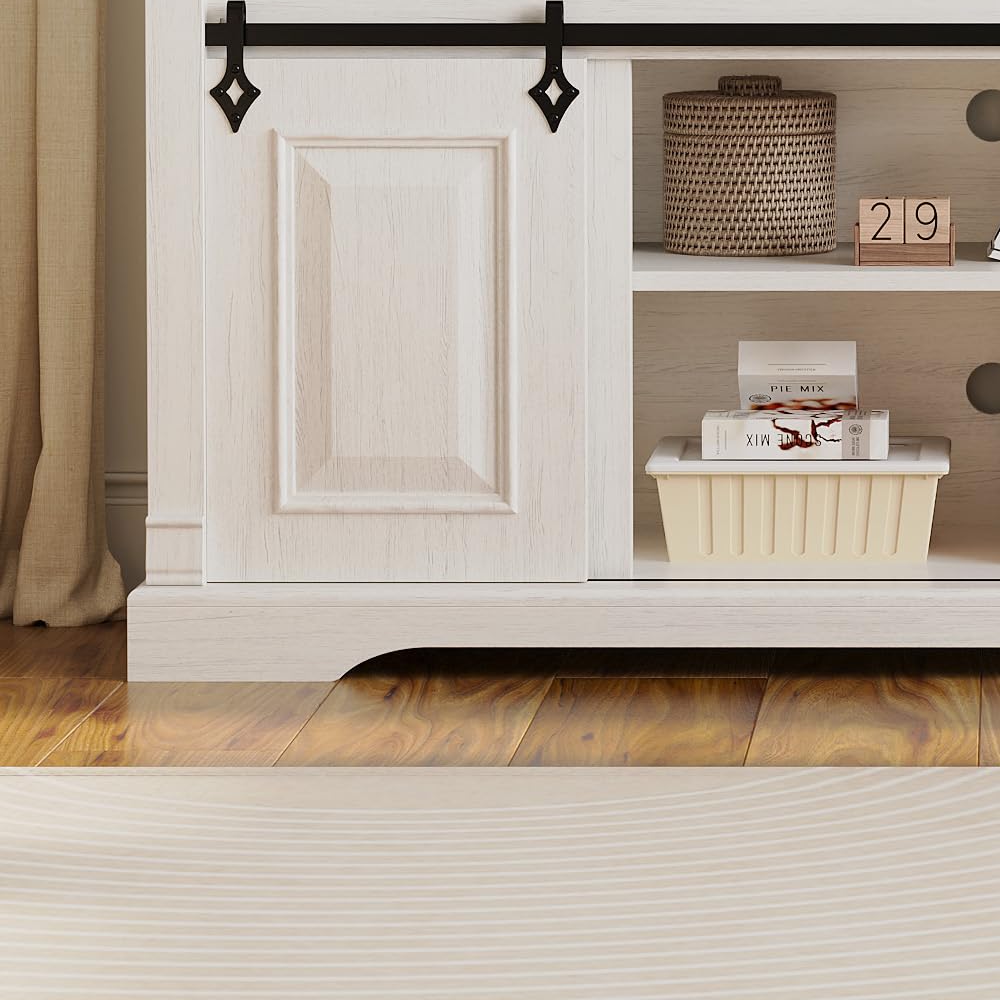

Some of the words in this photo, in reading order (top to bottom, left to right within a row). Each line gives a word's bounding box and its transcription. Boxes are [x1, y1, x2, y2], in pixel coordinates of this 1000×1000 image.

[770, 385, 792, 393] PIE
[800, 385, 825, 393] MIX
[746, 433, 770, 446] MIX
